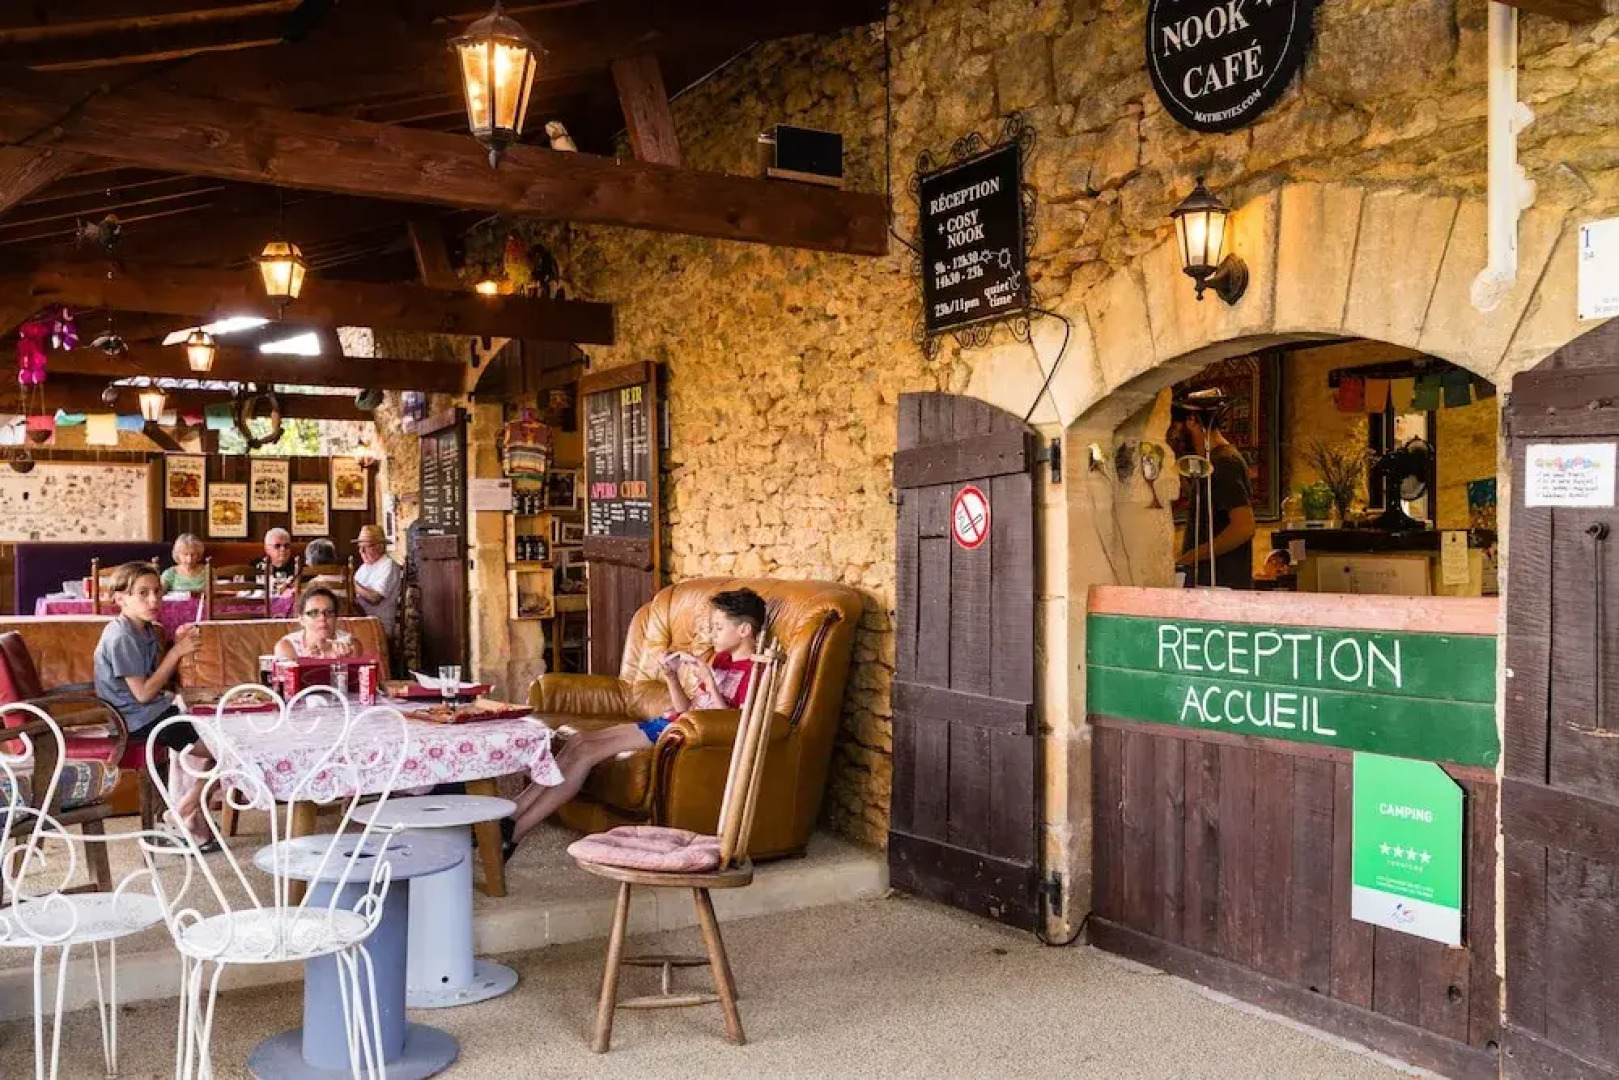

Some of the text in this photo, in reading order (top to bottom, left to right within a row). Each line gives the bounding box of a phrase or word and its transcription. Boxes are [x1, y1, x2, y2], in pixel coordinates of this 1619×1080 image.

[1161, 0, 1250, 57] NOOK
[1183, 38, 1264, 100] CAFÉ
[931, 176, 999, 215] RÉCEPTION
[947, 209, 979, 232] COSY
[947, 223, 985, 249] NOOK
[1158, 624, 1402, 688] RECEPTION
[1180, 685, 1337, 736] ACCUEIL
[1379, 802, 1433, 823] CAMPING
